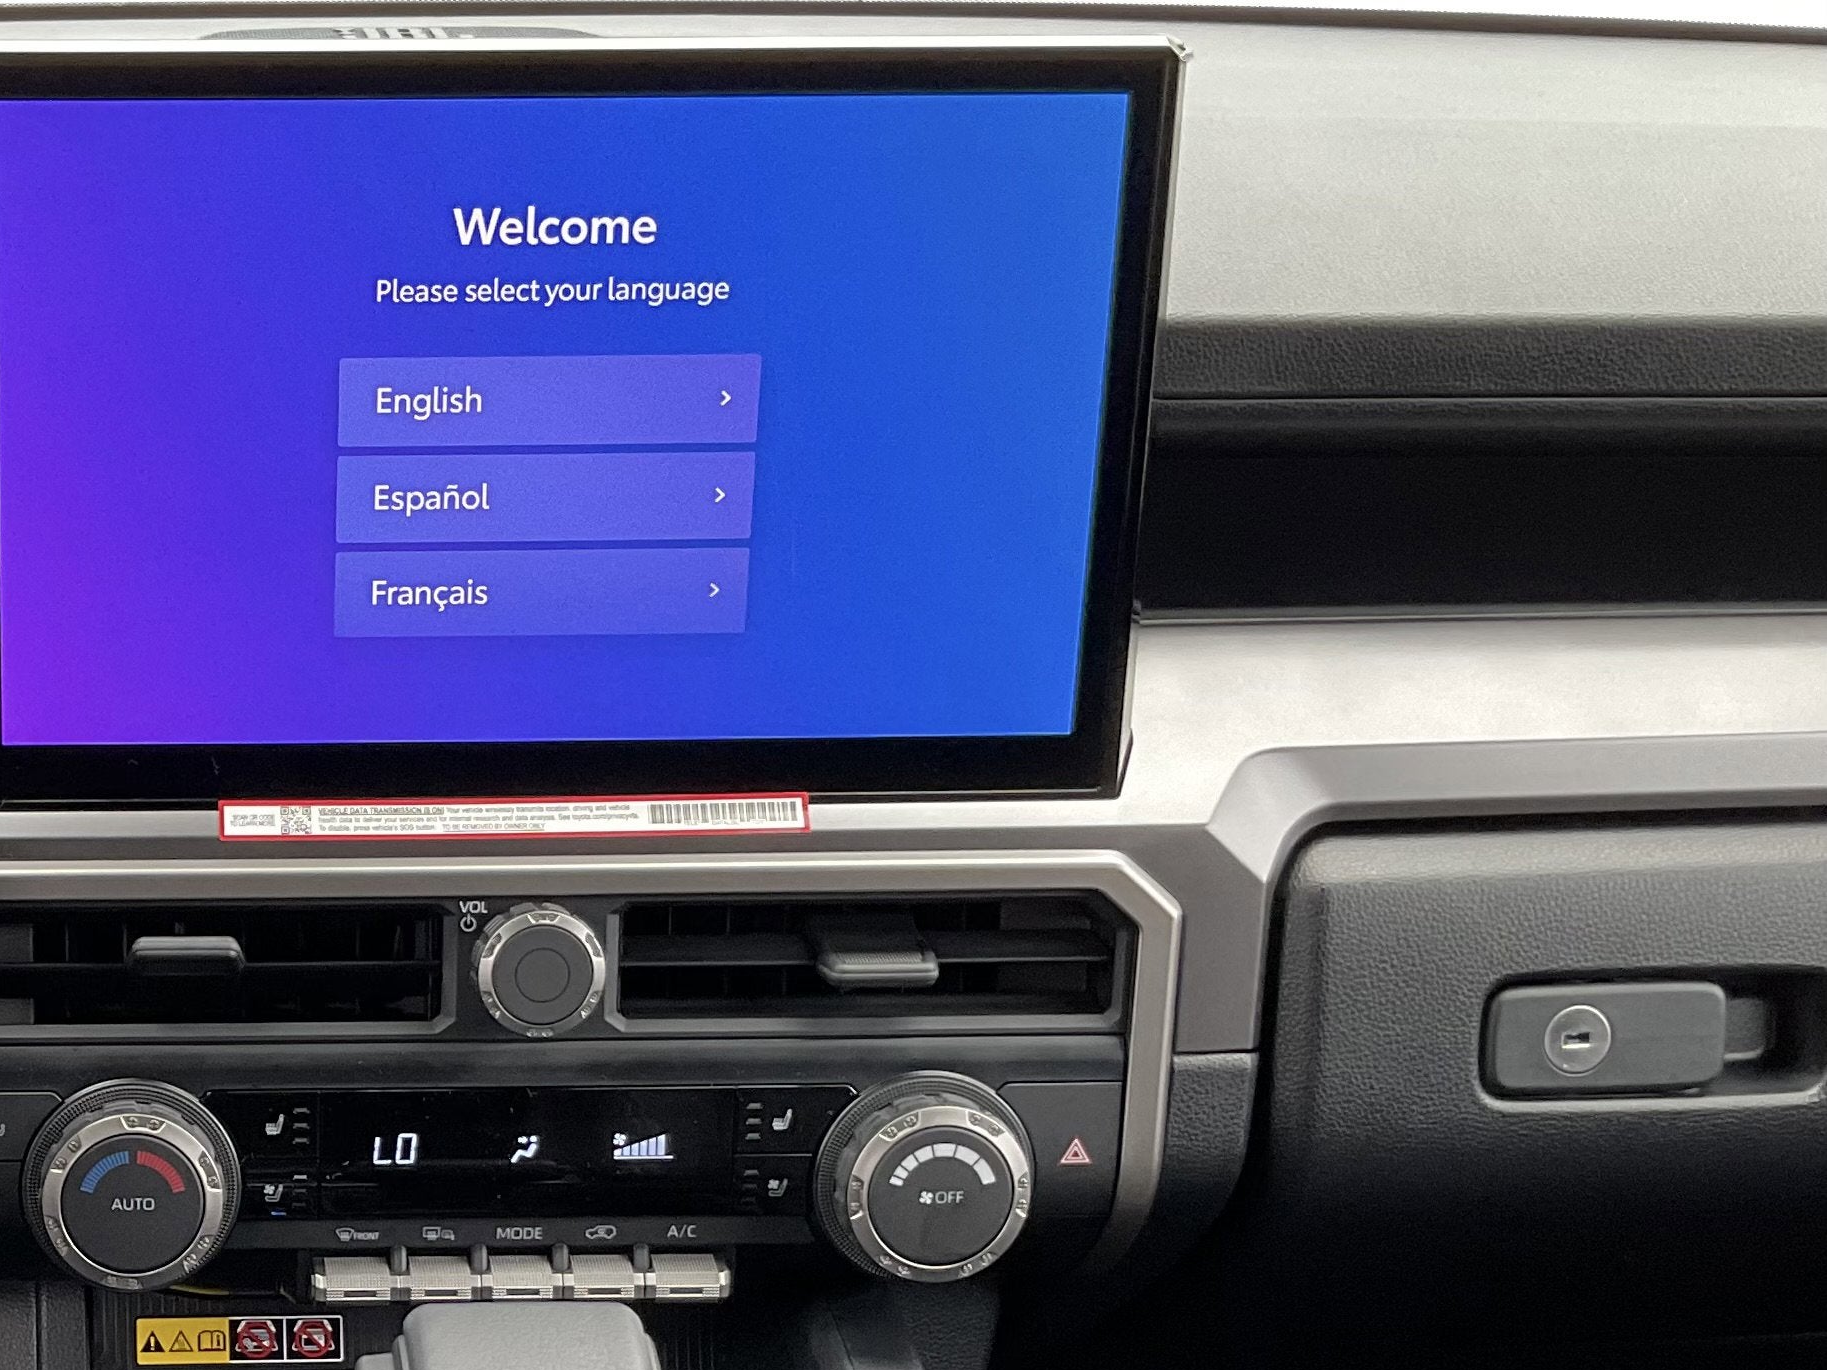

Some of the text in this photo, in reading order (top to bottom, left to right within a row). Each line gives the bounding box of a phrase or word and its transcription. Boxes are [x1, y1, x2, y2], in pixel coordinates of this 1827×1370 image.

[454, 206, 658, 246] Welcome
[376, 276, 730, 307] Please select your language
[376, 386, 483, 421] English
[374, 483, 490, 517] Español
[371, 579, 489, 612] Français
[459, 900, 488, 914] VOL
[373, 1132, 419, 1165] LO
[111, 1197, 155, 1212] AUTO
[935, 1190, 965, 1204] OFF
[353, 1231, 380, 1241] FRONT
[496, 1226, 543, 1240] MODE
[667, 1225, 697, 1239] A/C
